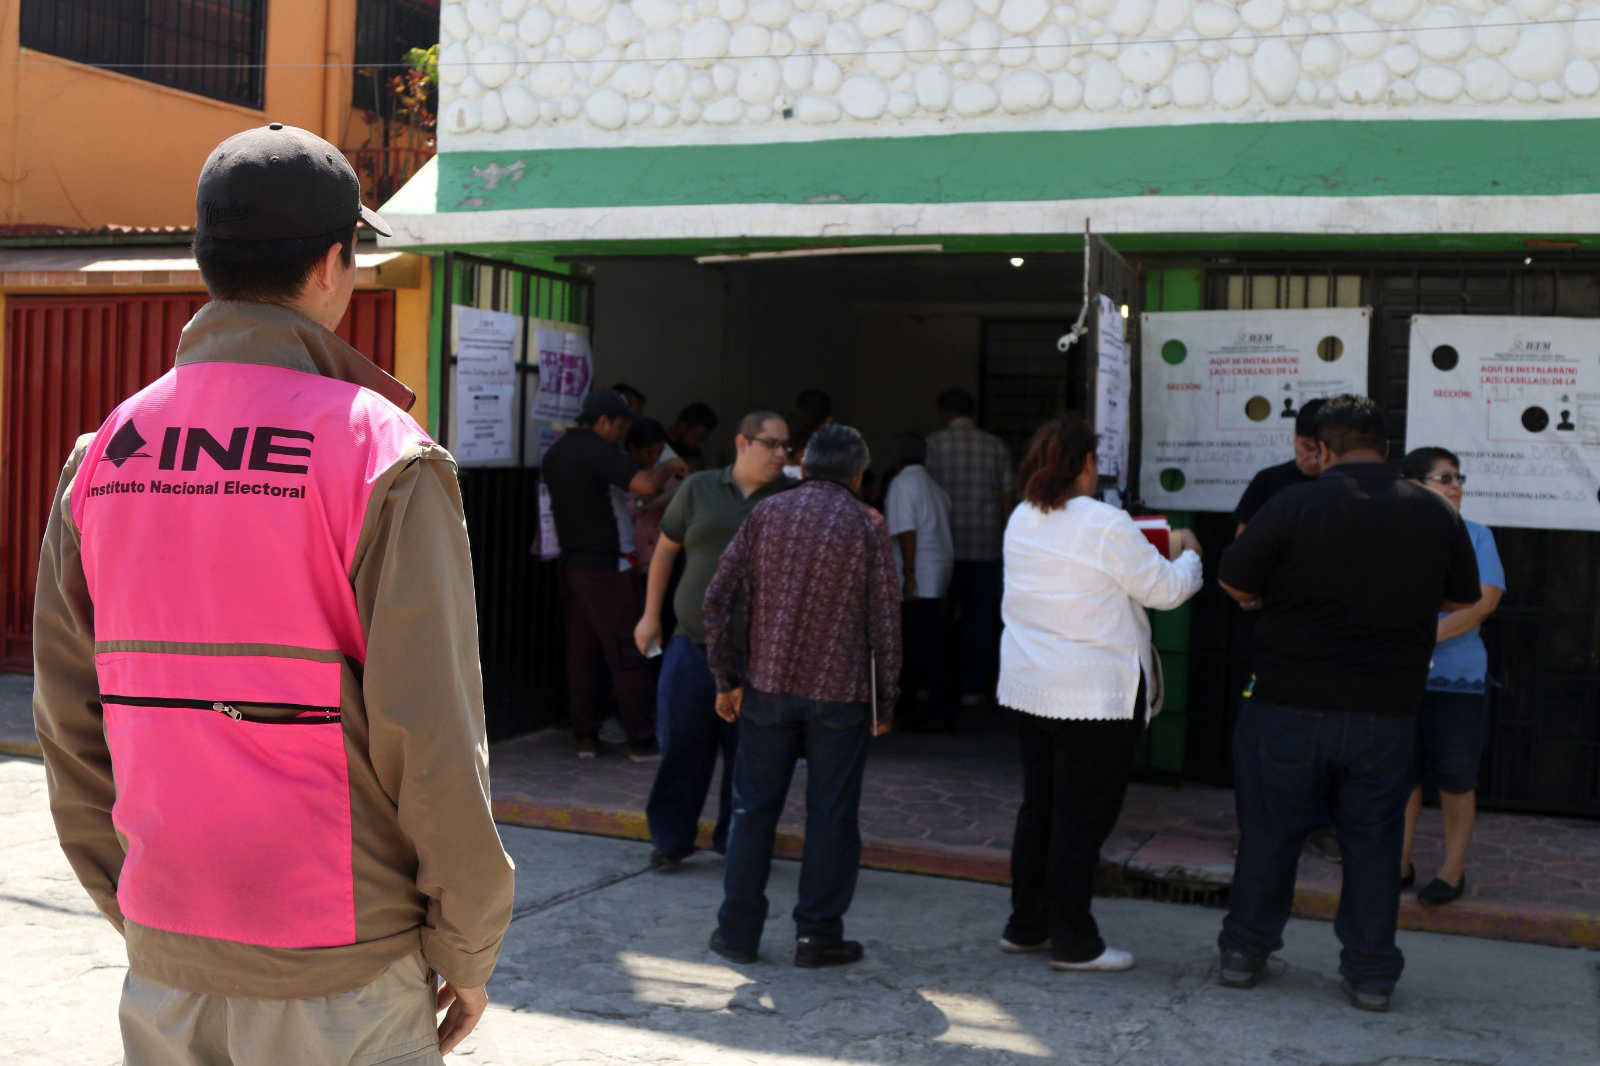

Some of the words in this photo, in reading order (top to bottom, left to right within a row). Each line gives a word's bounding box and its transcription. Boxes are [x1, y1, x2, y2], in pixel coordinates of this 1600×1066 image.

[1232, 357, 1241, 365] SE
[1209, 367, 1230, 376] LA(S)
[1231, 367, 1274, 376] CASILLA(S)
[1276, 367, 1286, 375] DE
[1289, 367, 1300, 375] LA
[1480, 376, 1502, 385] LA(S)
[1503, 376, 1551, 386] CASILLA(S)
[1552, 377, 1563, 385] DE
[1566, 378, 1577, 386] LA
[158, 426, 315, 475] INE
[87, 480, 145, 498] Instituto
[150, 480, 219, 496] Nacional
[223, 480, 306, 499] Electoral
[1495, 491, 1532, 499] ELECTORAL
